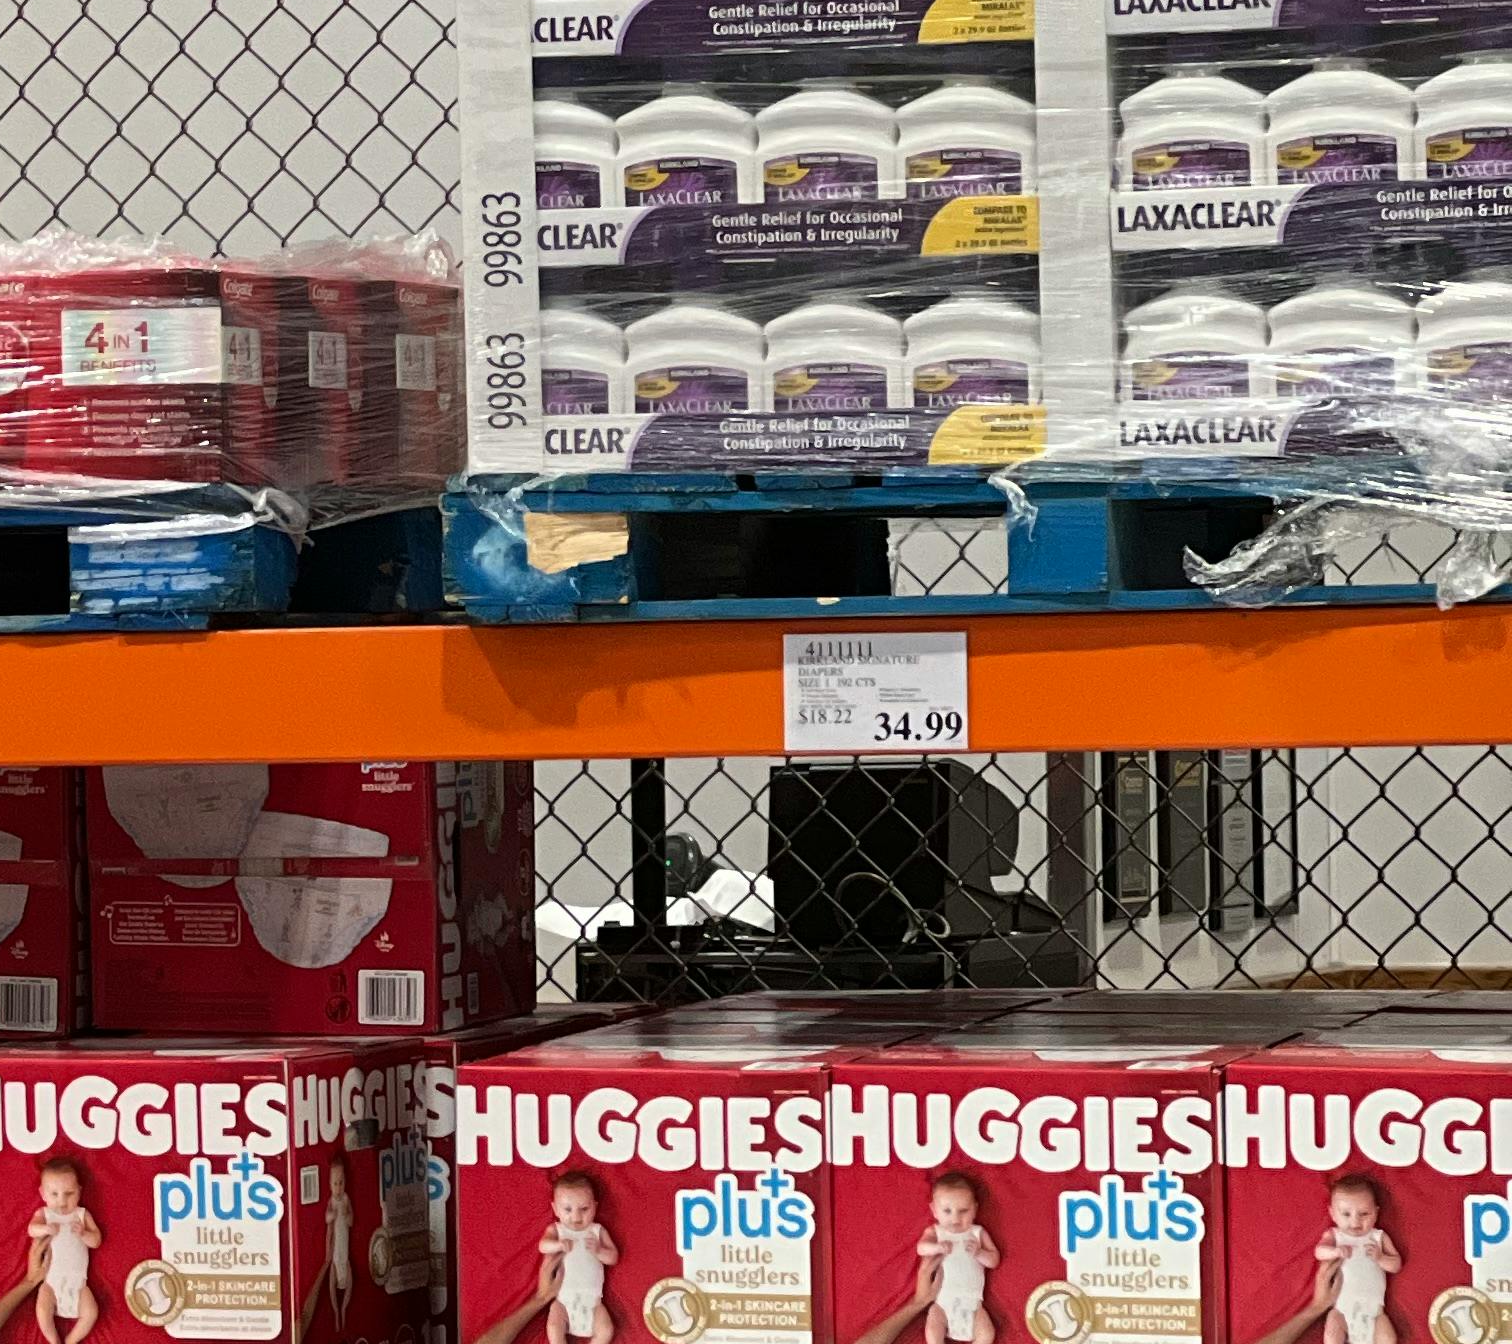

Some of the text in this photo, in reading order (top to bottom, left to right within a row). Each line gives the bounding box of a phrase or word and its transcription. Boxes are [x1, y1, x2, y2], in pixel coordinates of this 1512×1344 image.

[712, 208, 903, 228] Gentle Relief for Occasional
[482, 191, 522, 287] 99863
[715, 224, 899, 245] Constipation & Irregularity
[83, 322, 150, 353] 4 IN 1
[798, 668, 843, 676] DIAPERS
[798, 678, 821, 687] SIZE
[855, 678, 876, 686] CTS
[798, 709, 962, 741] $18.22 34.99
[456, 1084, 826, 1173] HUGGIES
